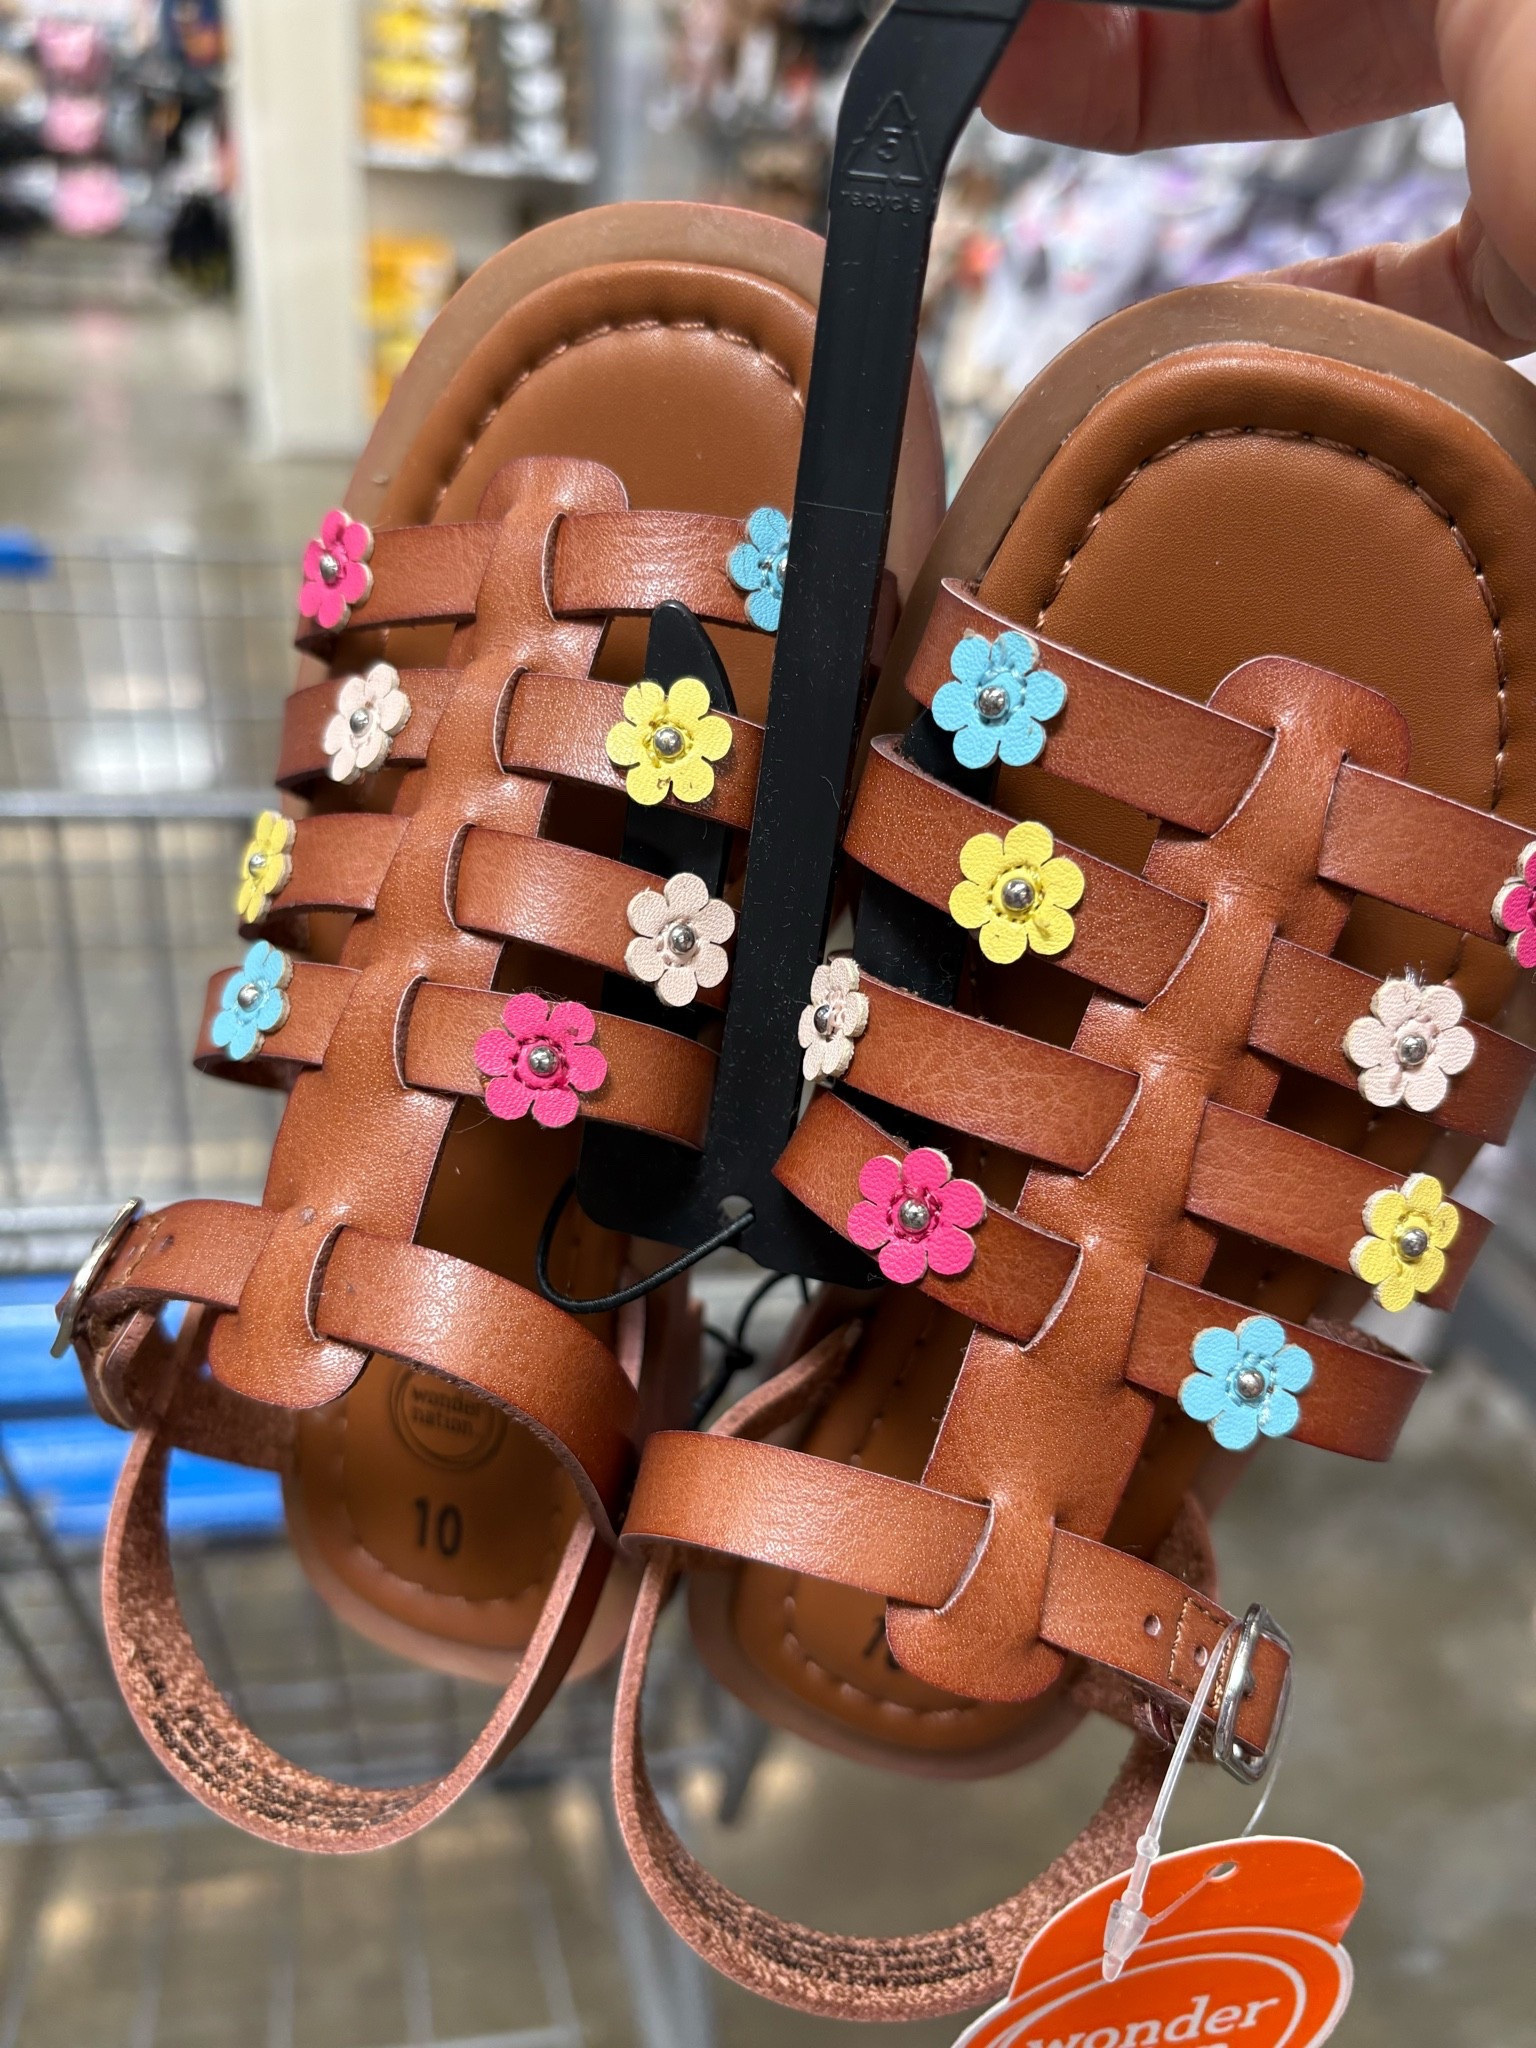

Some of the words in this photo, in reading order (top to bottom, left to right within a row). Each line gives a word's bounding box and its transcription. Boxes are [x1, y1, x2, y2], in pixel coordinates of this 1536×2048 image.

[877, 126, 903, 160] 5
[413, 1388, 480, 1416] wonder
[414, 1496, 463, 1557] 10
